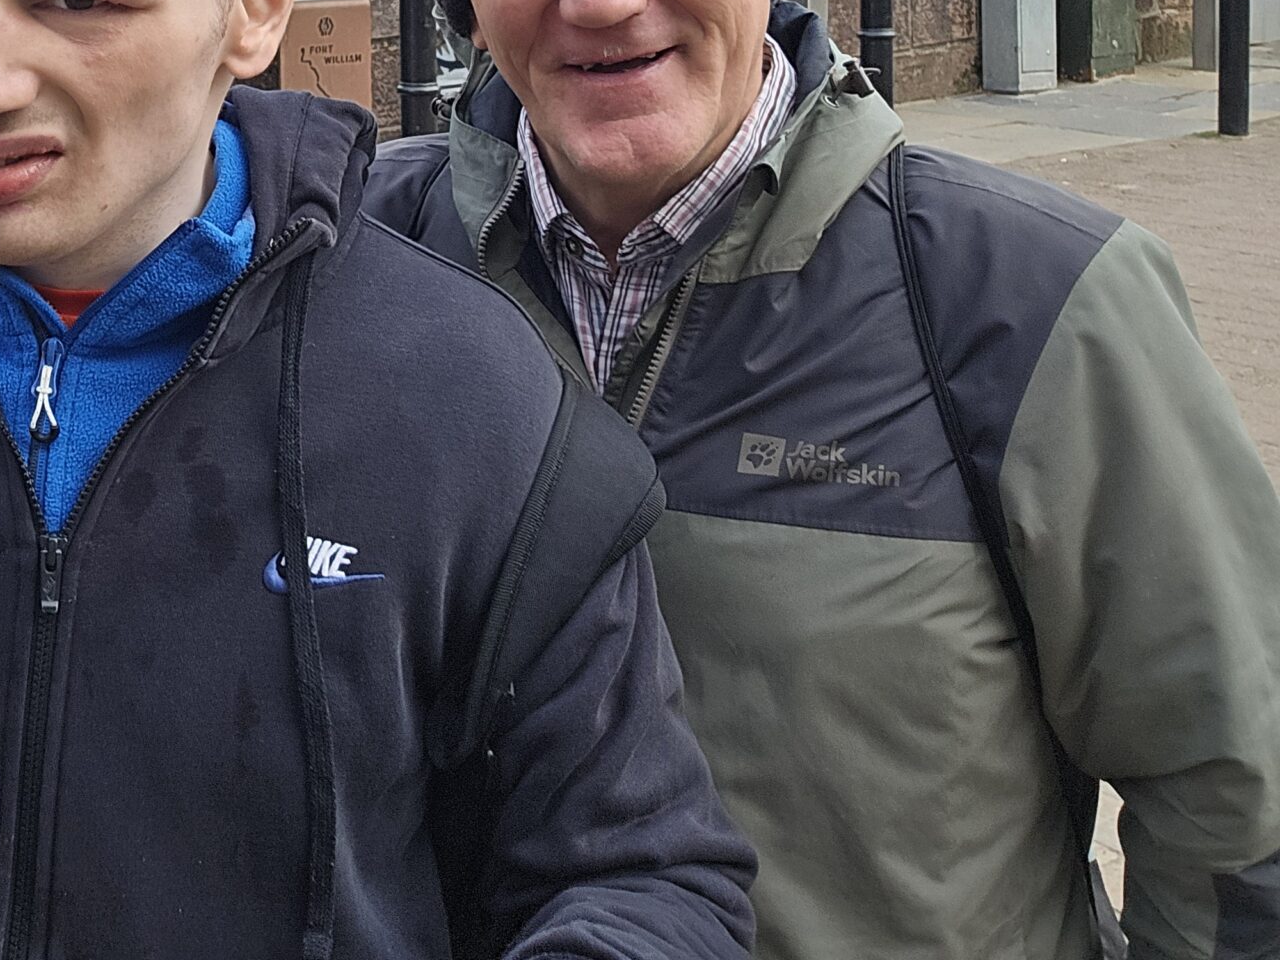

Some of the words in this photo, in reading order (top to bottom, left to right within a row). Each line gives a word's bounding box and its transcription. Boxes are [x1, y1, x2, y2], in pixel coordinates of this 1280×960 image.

[309, 44, 334, 55] FORT
[324, 53, 362, 65] WILLIAM
[788, 440, 846, 463] Jack
[786, 457, 902, 488] Wolfskin
[281, 536, 359, 577] IKE
